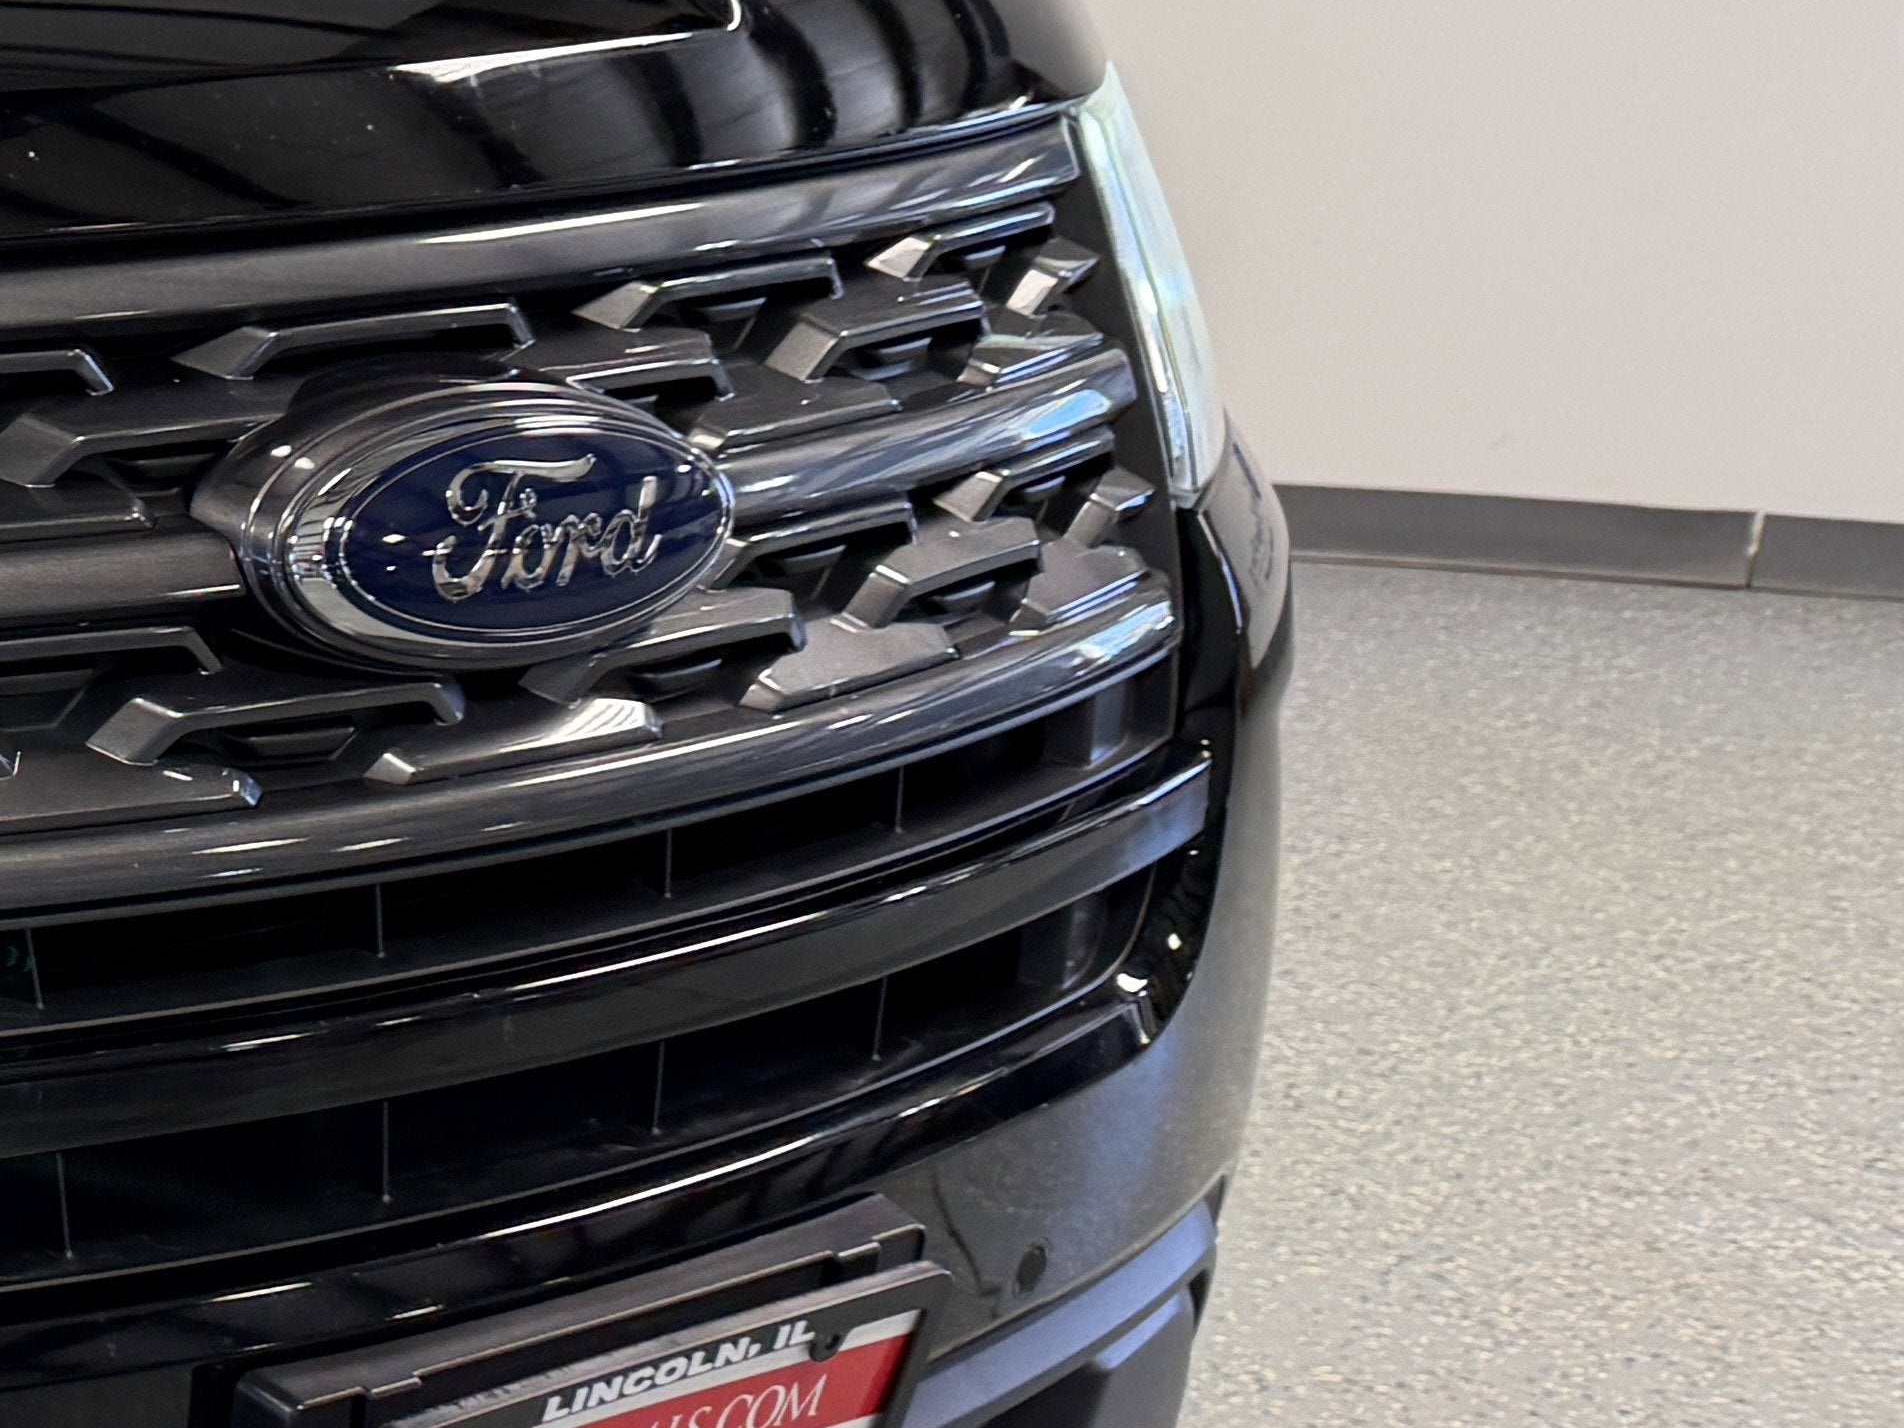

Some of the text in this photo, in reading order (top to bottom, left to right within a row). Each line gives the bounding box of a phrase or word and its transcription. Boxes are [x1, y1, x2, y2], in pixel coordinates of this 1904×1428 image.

[431, 453, 663, 603] Ford
[542, 1320, 816, 1422] LINCOLN, IL
